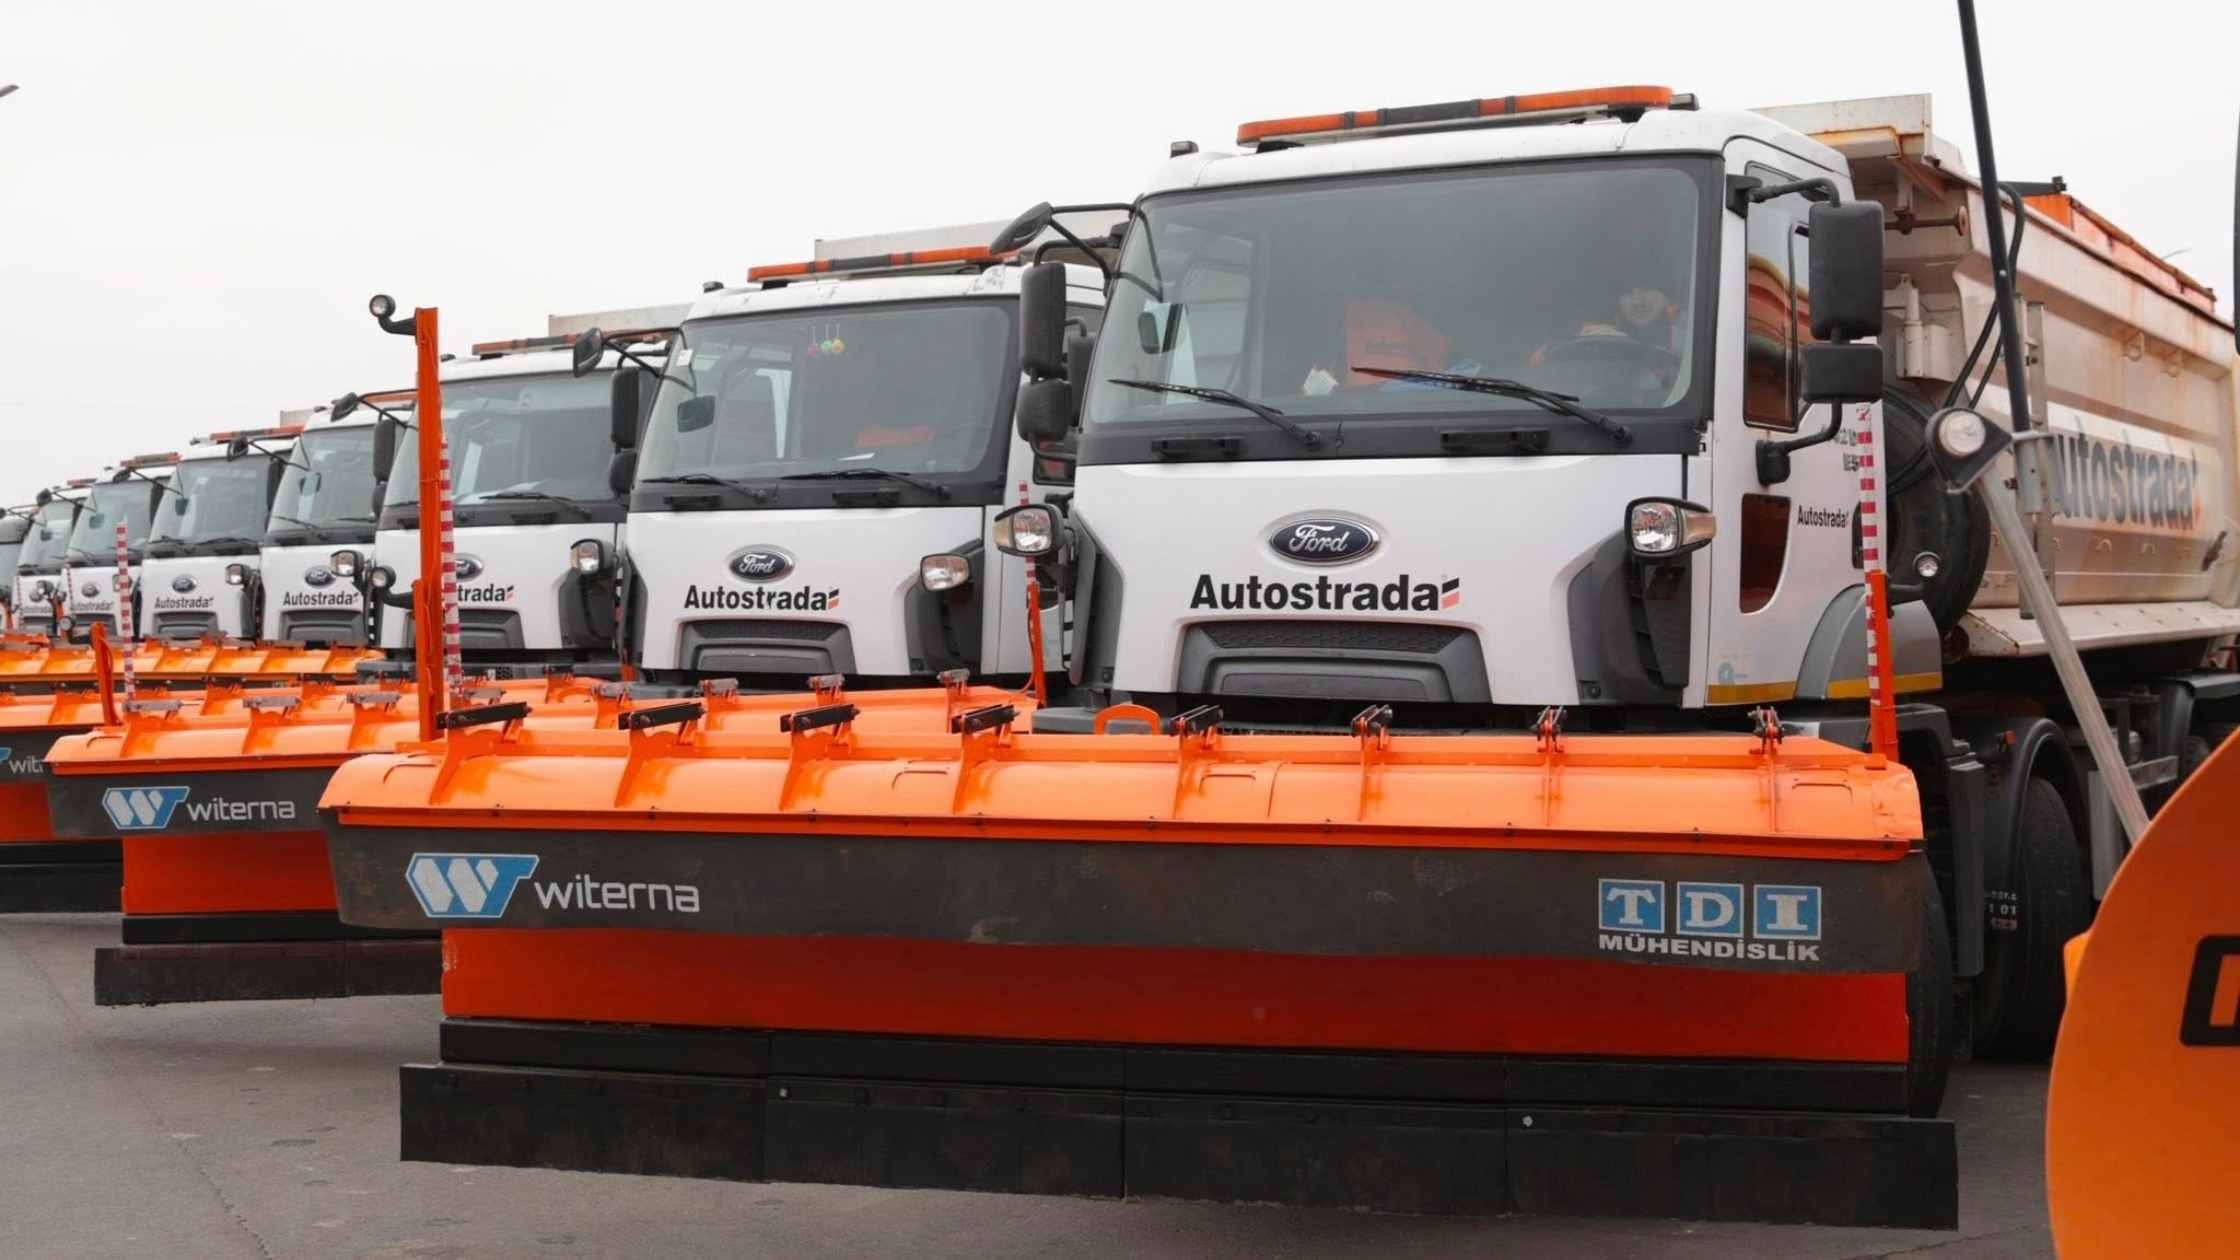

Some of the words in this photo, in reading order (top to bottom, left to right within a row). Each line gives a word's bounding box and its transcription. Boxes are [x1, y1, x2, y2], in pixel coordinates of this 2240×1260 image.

[1797, 505, 1848, 528] Autostrada
[1289, 523, 1350, 553] Ford
[739, 552, 776, 574] Ford
[154, 596, 209, 610] Autostrada
[283, 591, 353, 607] Autostrada
[457, 583, 506, 602] trada
[683, 585, 828, 611] Autostrada
[1190, 573, 1440, 612] Autostrada
[187, 797, 296, 821] witerna
[534, 874, 700, 913] witerna
[1599, 933, 1820, 961] MÜHENDİSLİK
